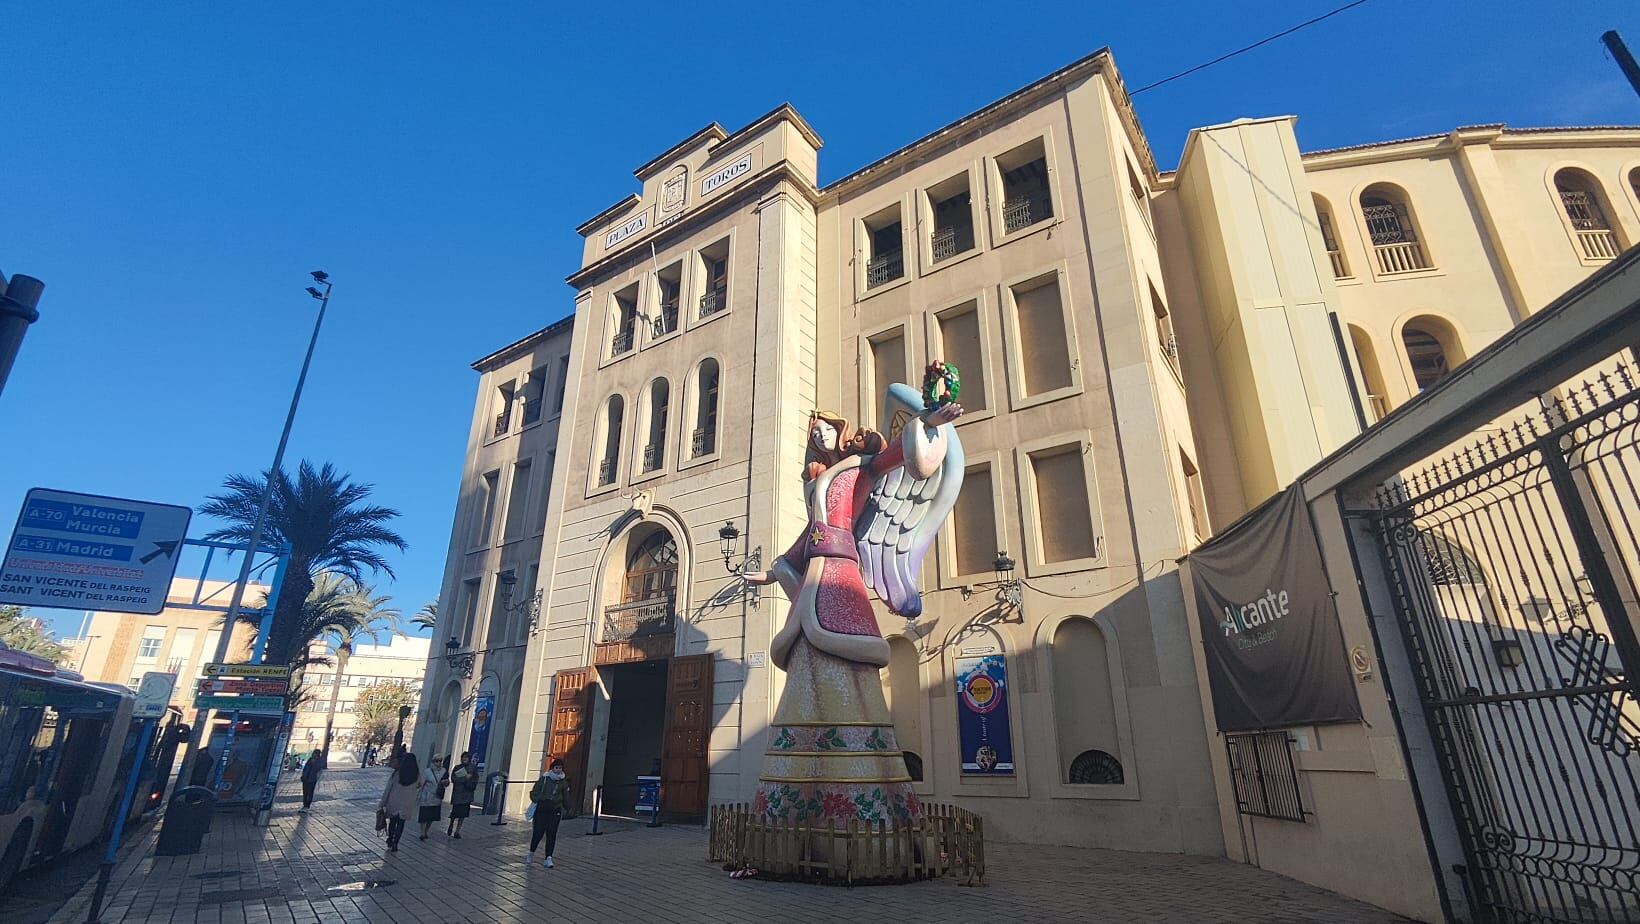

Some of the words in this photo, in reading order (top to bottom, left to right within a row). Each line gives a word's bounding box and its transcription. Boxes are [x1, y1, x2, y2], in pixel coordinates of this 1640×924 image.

[705, 159, 748, 190] TOROS
[608, 218, 643, 245] PLAZA
[29, 508, 63, 520] A-70
[72, 505, 139, 523] Valencia
[66, 520, 121, 535] Murcia
[18, 538, 51, 550] A-31
[56, 541, 114, 558] Madrid
[3, 573, 32, 583] SAN
[35, 576, 89, 588] VICENTE
[90, 582, 108, 591] DEL
[109, 584, 151, 594] RASPEIG
[0, 584, 34, 595] SANT
[40, 588, 85, 599] VICENT
[86, 593, 105, 601] DEL
[106, 594, 148, 604] RASPEIG
[1220, 588, 1289, 636] Alicante
